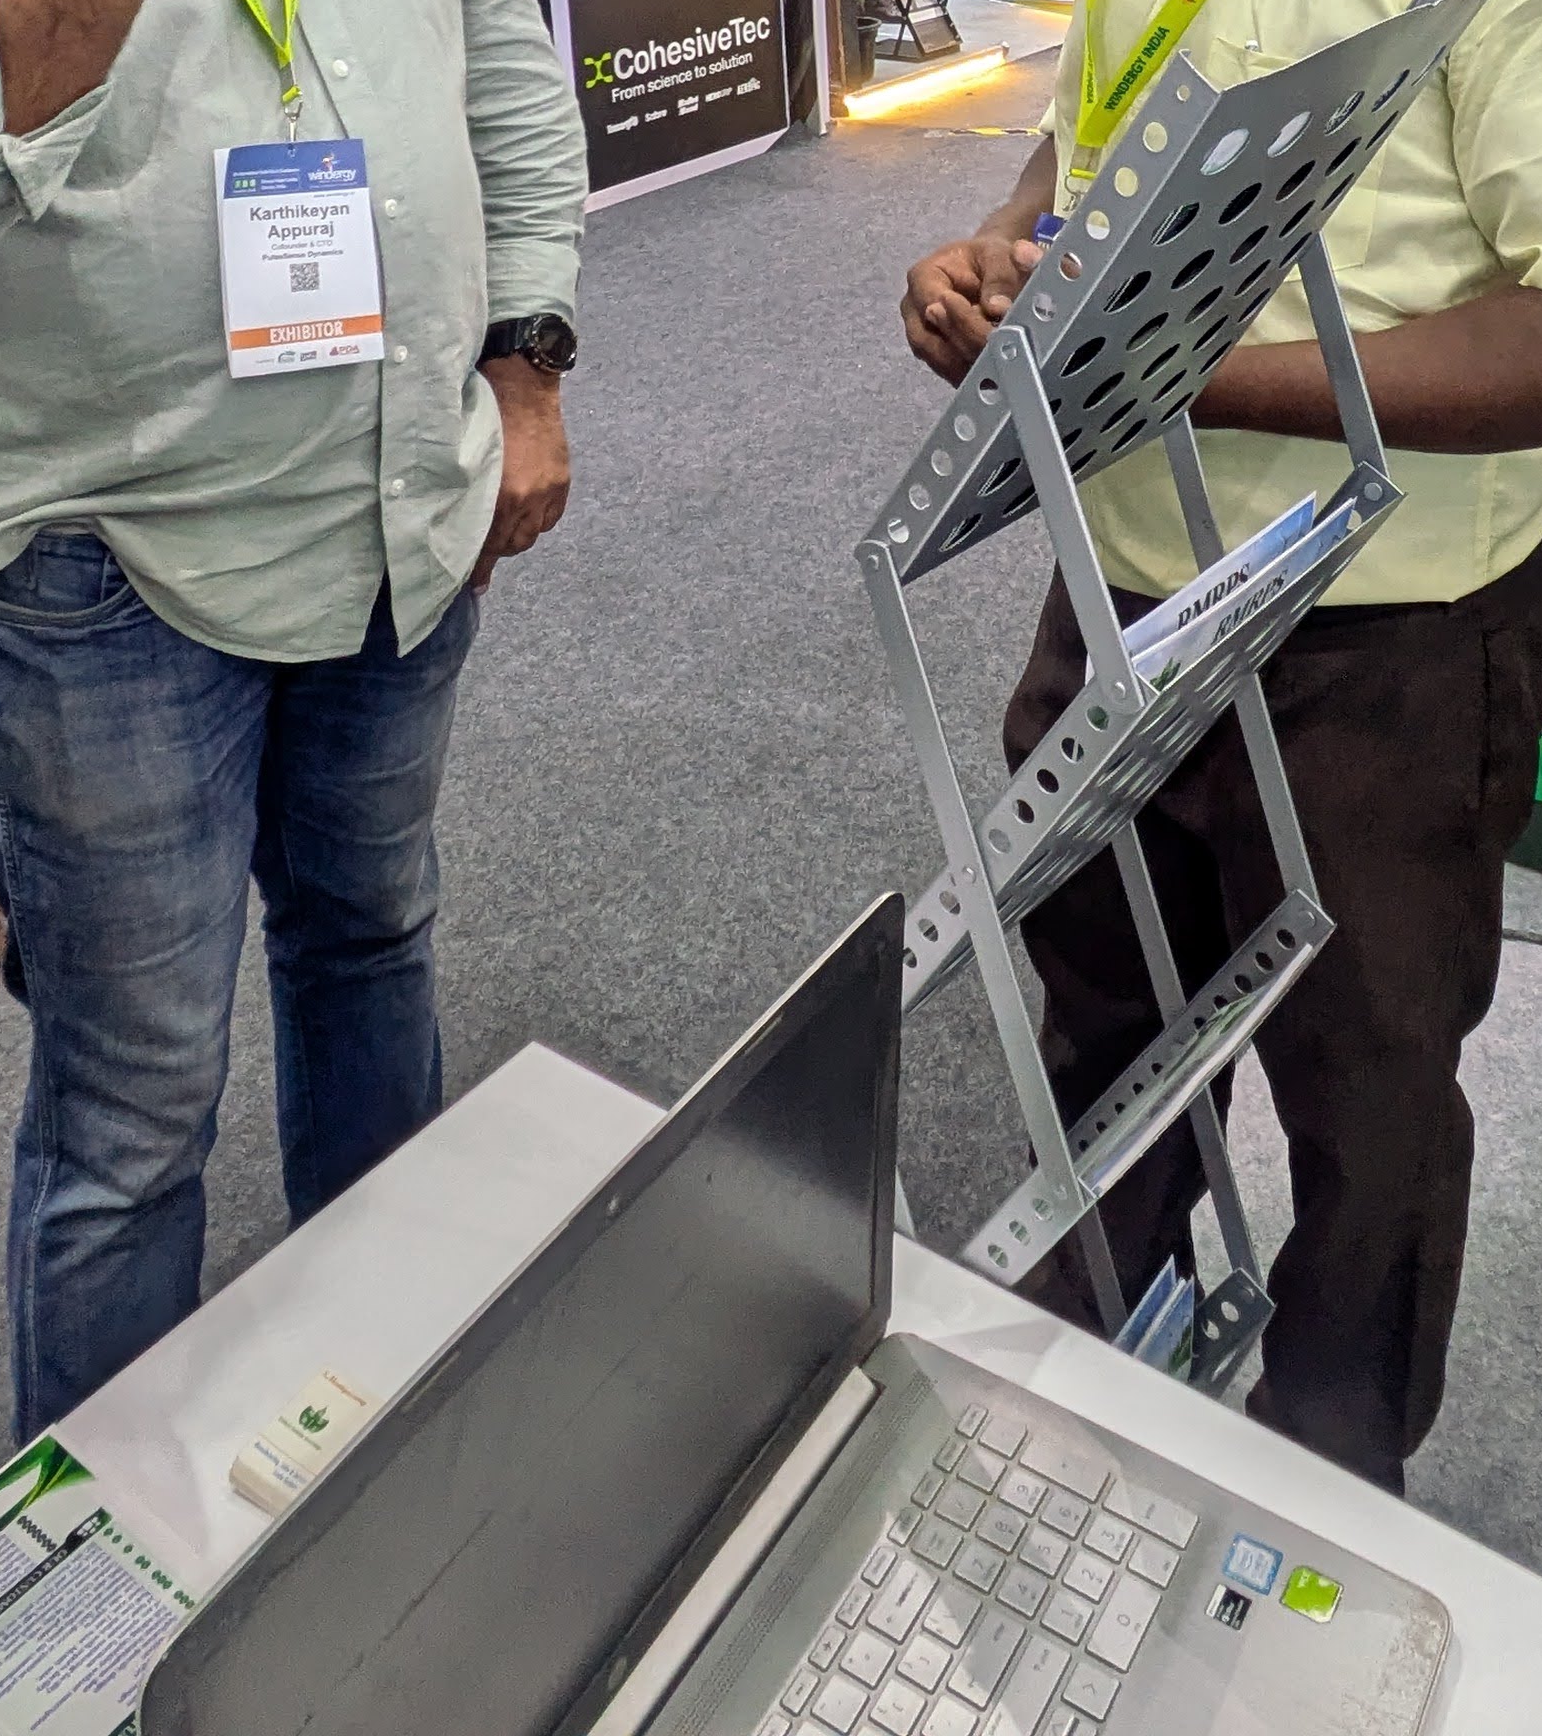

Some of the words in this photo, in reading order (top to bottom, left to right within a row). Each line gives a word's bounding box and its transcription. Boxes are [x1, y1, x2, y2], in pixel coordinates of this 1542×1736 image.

[613, 16, 772, 81] CohesiveTec
[611, 83, 646, 104] From
[647, 69, 693, 94] science
[694, 63, 707, 79] to
[708, 50, 754, 75] solution
[1104, 55, 1149, 112] WINDERGY
[1141, 25, 1171, 65] INDIA
[249, 204, 351, 222] Karthikeyan
[267, 221, 335, 242] Appuraj
[269, 320, 344, 344] EXHIBITOR
